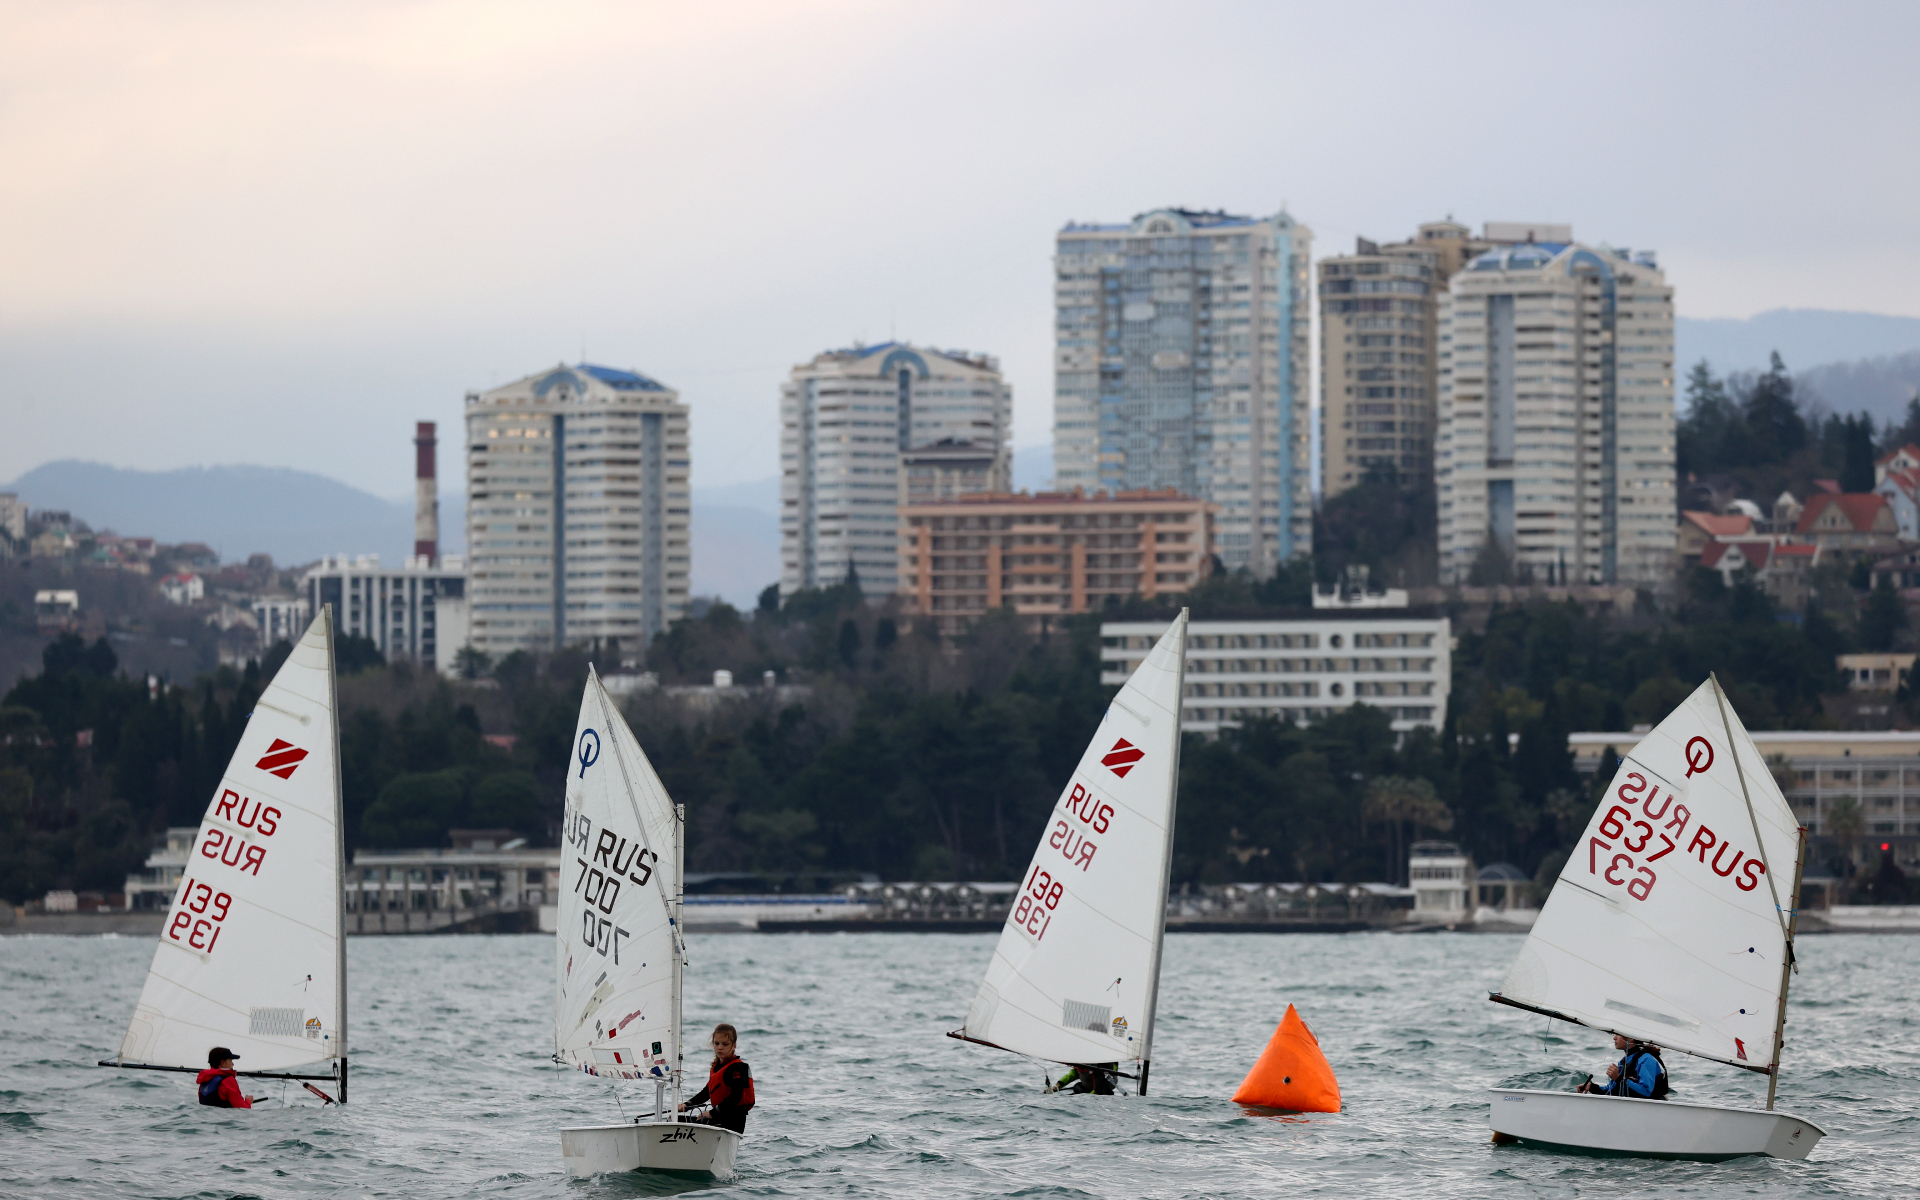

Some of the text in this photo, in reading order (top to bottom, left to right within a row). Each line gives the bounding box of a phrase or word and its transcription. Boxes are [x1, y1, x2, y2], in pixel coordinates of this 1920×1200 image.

[215, 789, 281, 836] RUS
[1066, 783, 1114, 834] RUS
[1599, 805, 1675, 862] 637
[594, 828, 658, 886] RUS
[1687, 825, 1765, 891] RUS
[181, 878, 232, 922] 139
[575, 857, 620, 914] 700
[1027, 865, 1063, 910] 138
[659, 1127, 698, 1144] zhik
